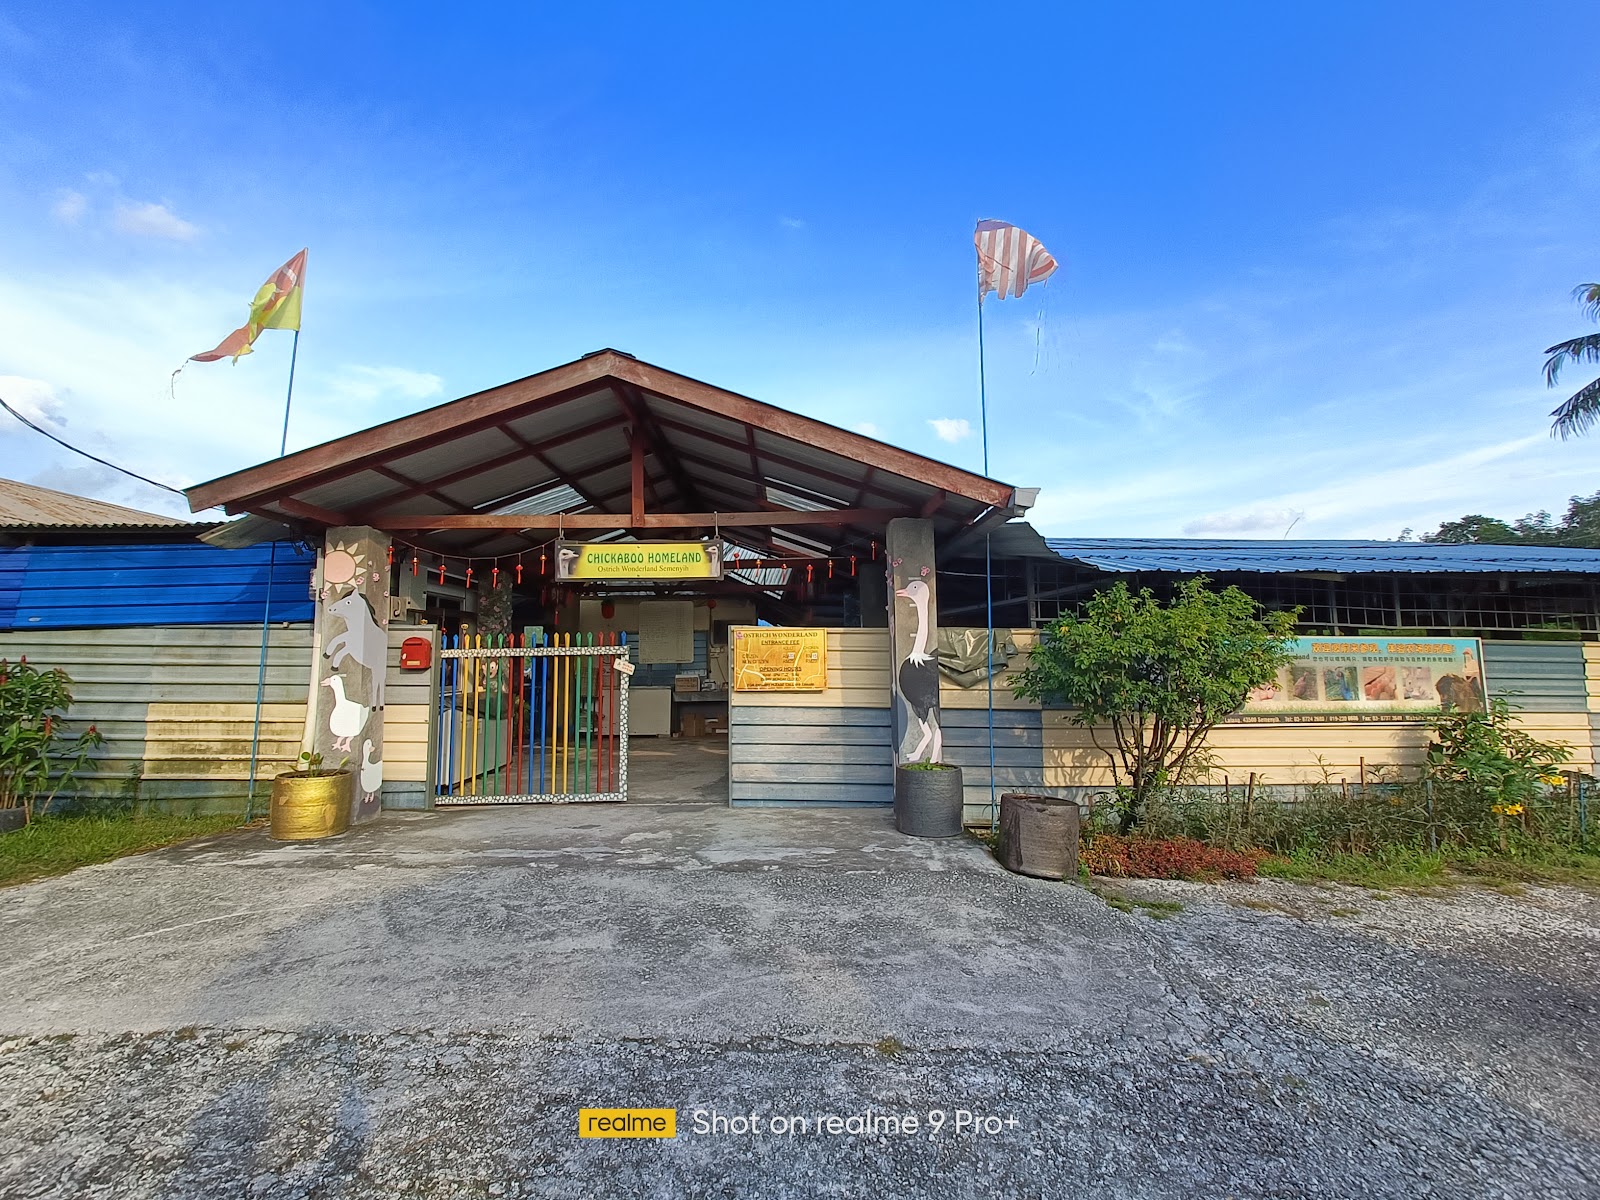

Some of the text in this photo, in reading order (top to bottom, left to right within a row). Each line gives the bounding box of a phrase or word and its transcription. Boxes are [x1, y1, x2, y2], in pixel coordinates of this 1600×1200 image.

[587, 552, 701, 563] CHICKABOO HOMELAND
[597, 565, 620, 573] Ostrich
[659, 565, 690, 573] Semenyih
